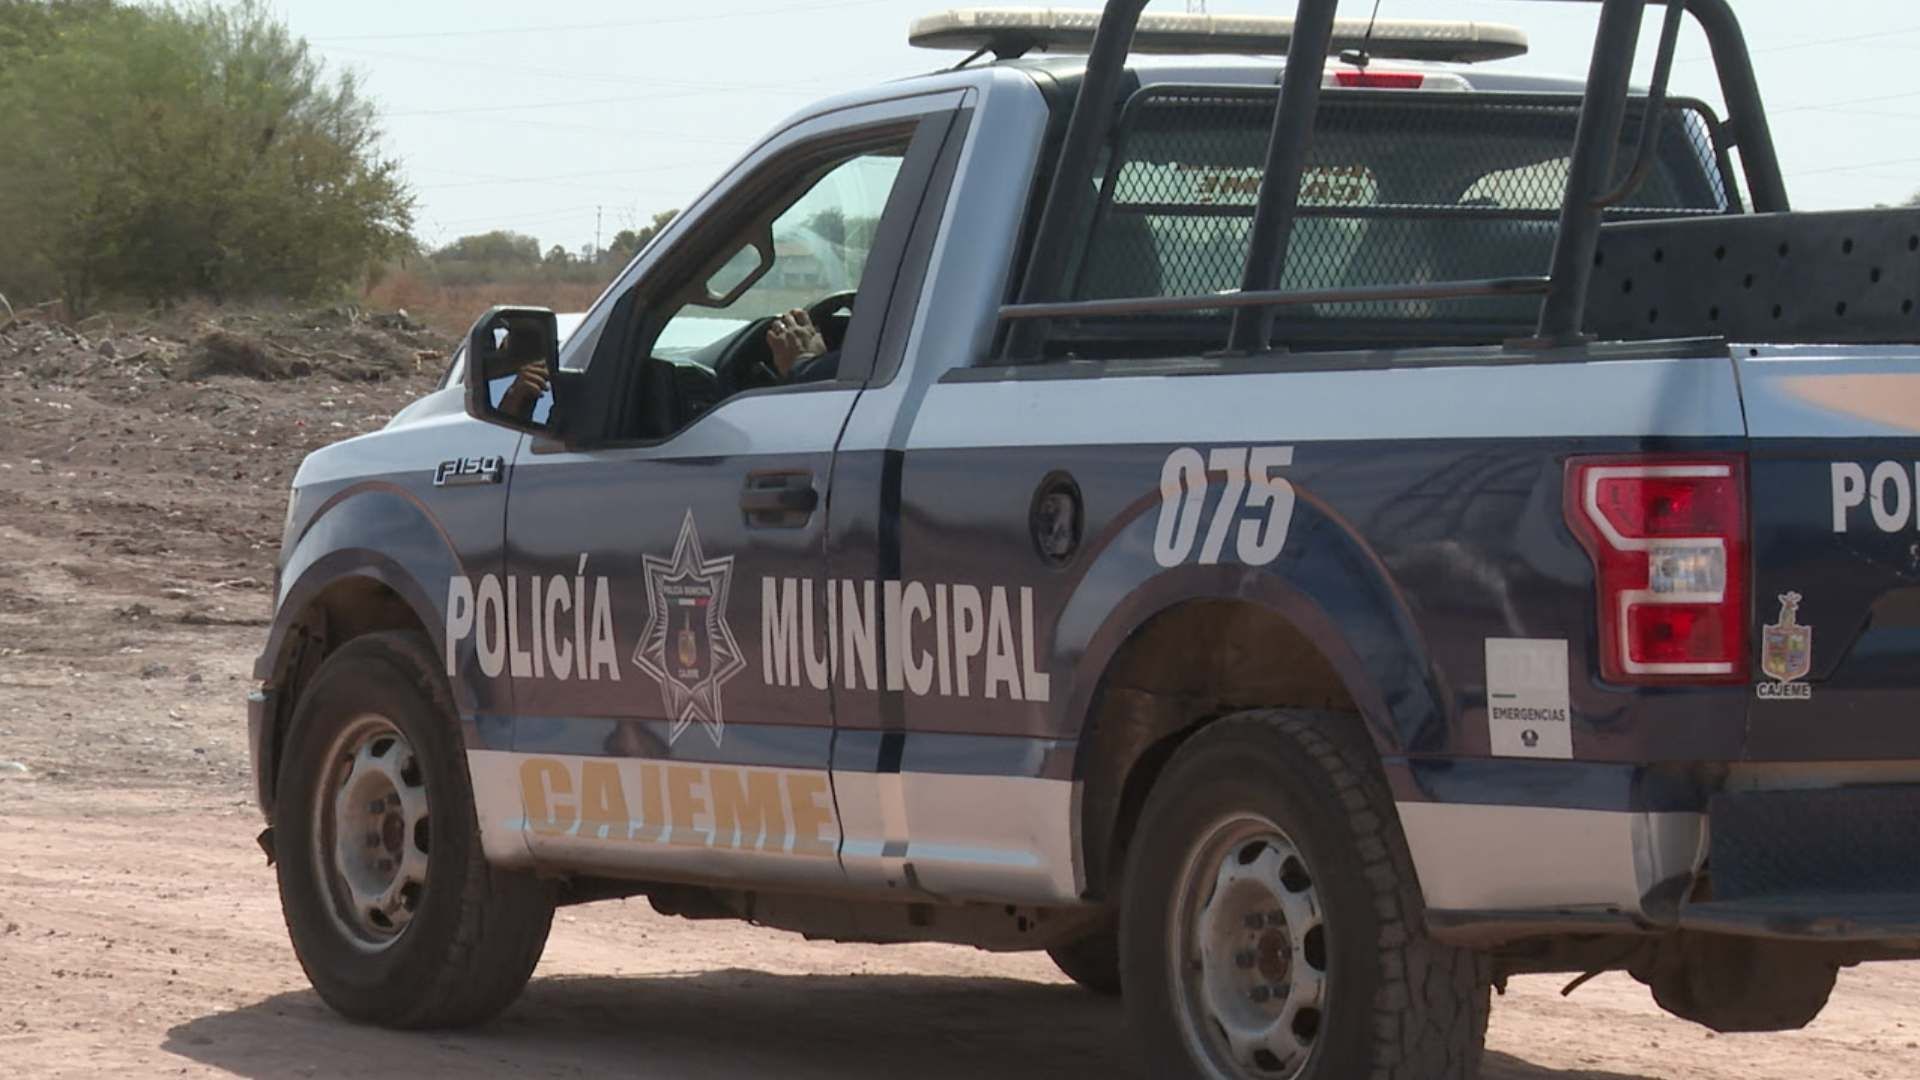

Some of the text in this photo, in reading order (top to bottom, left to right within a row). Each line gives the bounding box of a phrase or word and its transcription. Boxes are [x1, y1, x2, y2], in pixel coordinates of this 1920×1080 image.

[433, 456, 500, 486] F150
[1153, 445, 1296, 568] 075
[1830, 460, 1920, 533] PO
[445, 552, 1051, 702] POLICÍA MUNICIPAL
[1492, 706, 1566, 721] EMERGENCIAS
[1757, 682, 1811, 699] CAJEME
[518, 757, 838, 857] CAJEME
